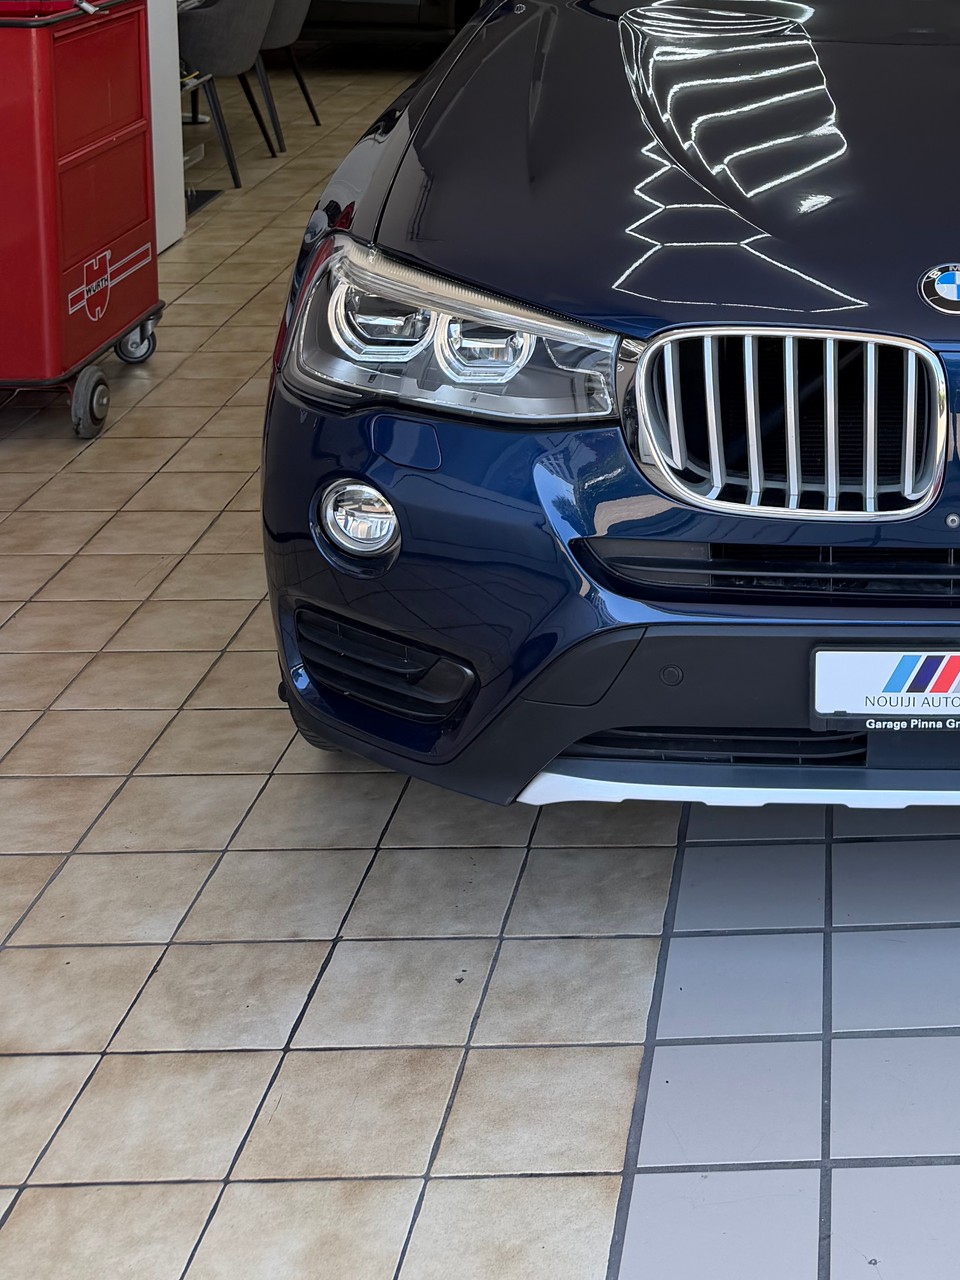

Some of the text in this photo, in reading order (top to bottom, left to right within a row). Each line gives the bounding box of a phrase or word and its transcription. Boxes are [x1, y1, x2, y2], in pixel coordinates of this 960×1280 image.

[864, 695, 916, 708] NOUIJI
[865, 719, 908, 731] Garage
[910, 719, 943, 729] Pinna
